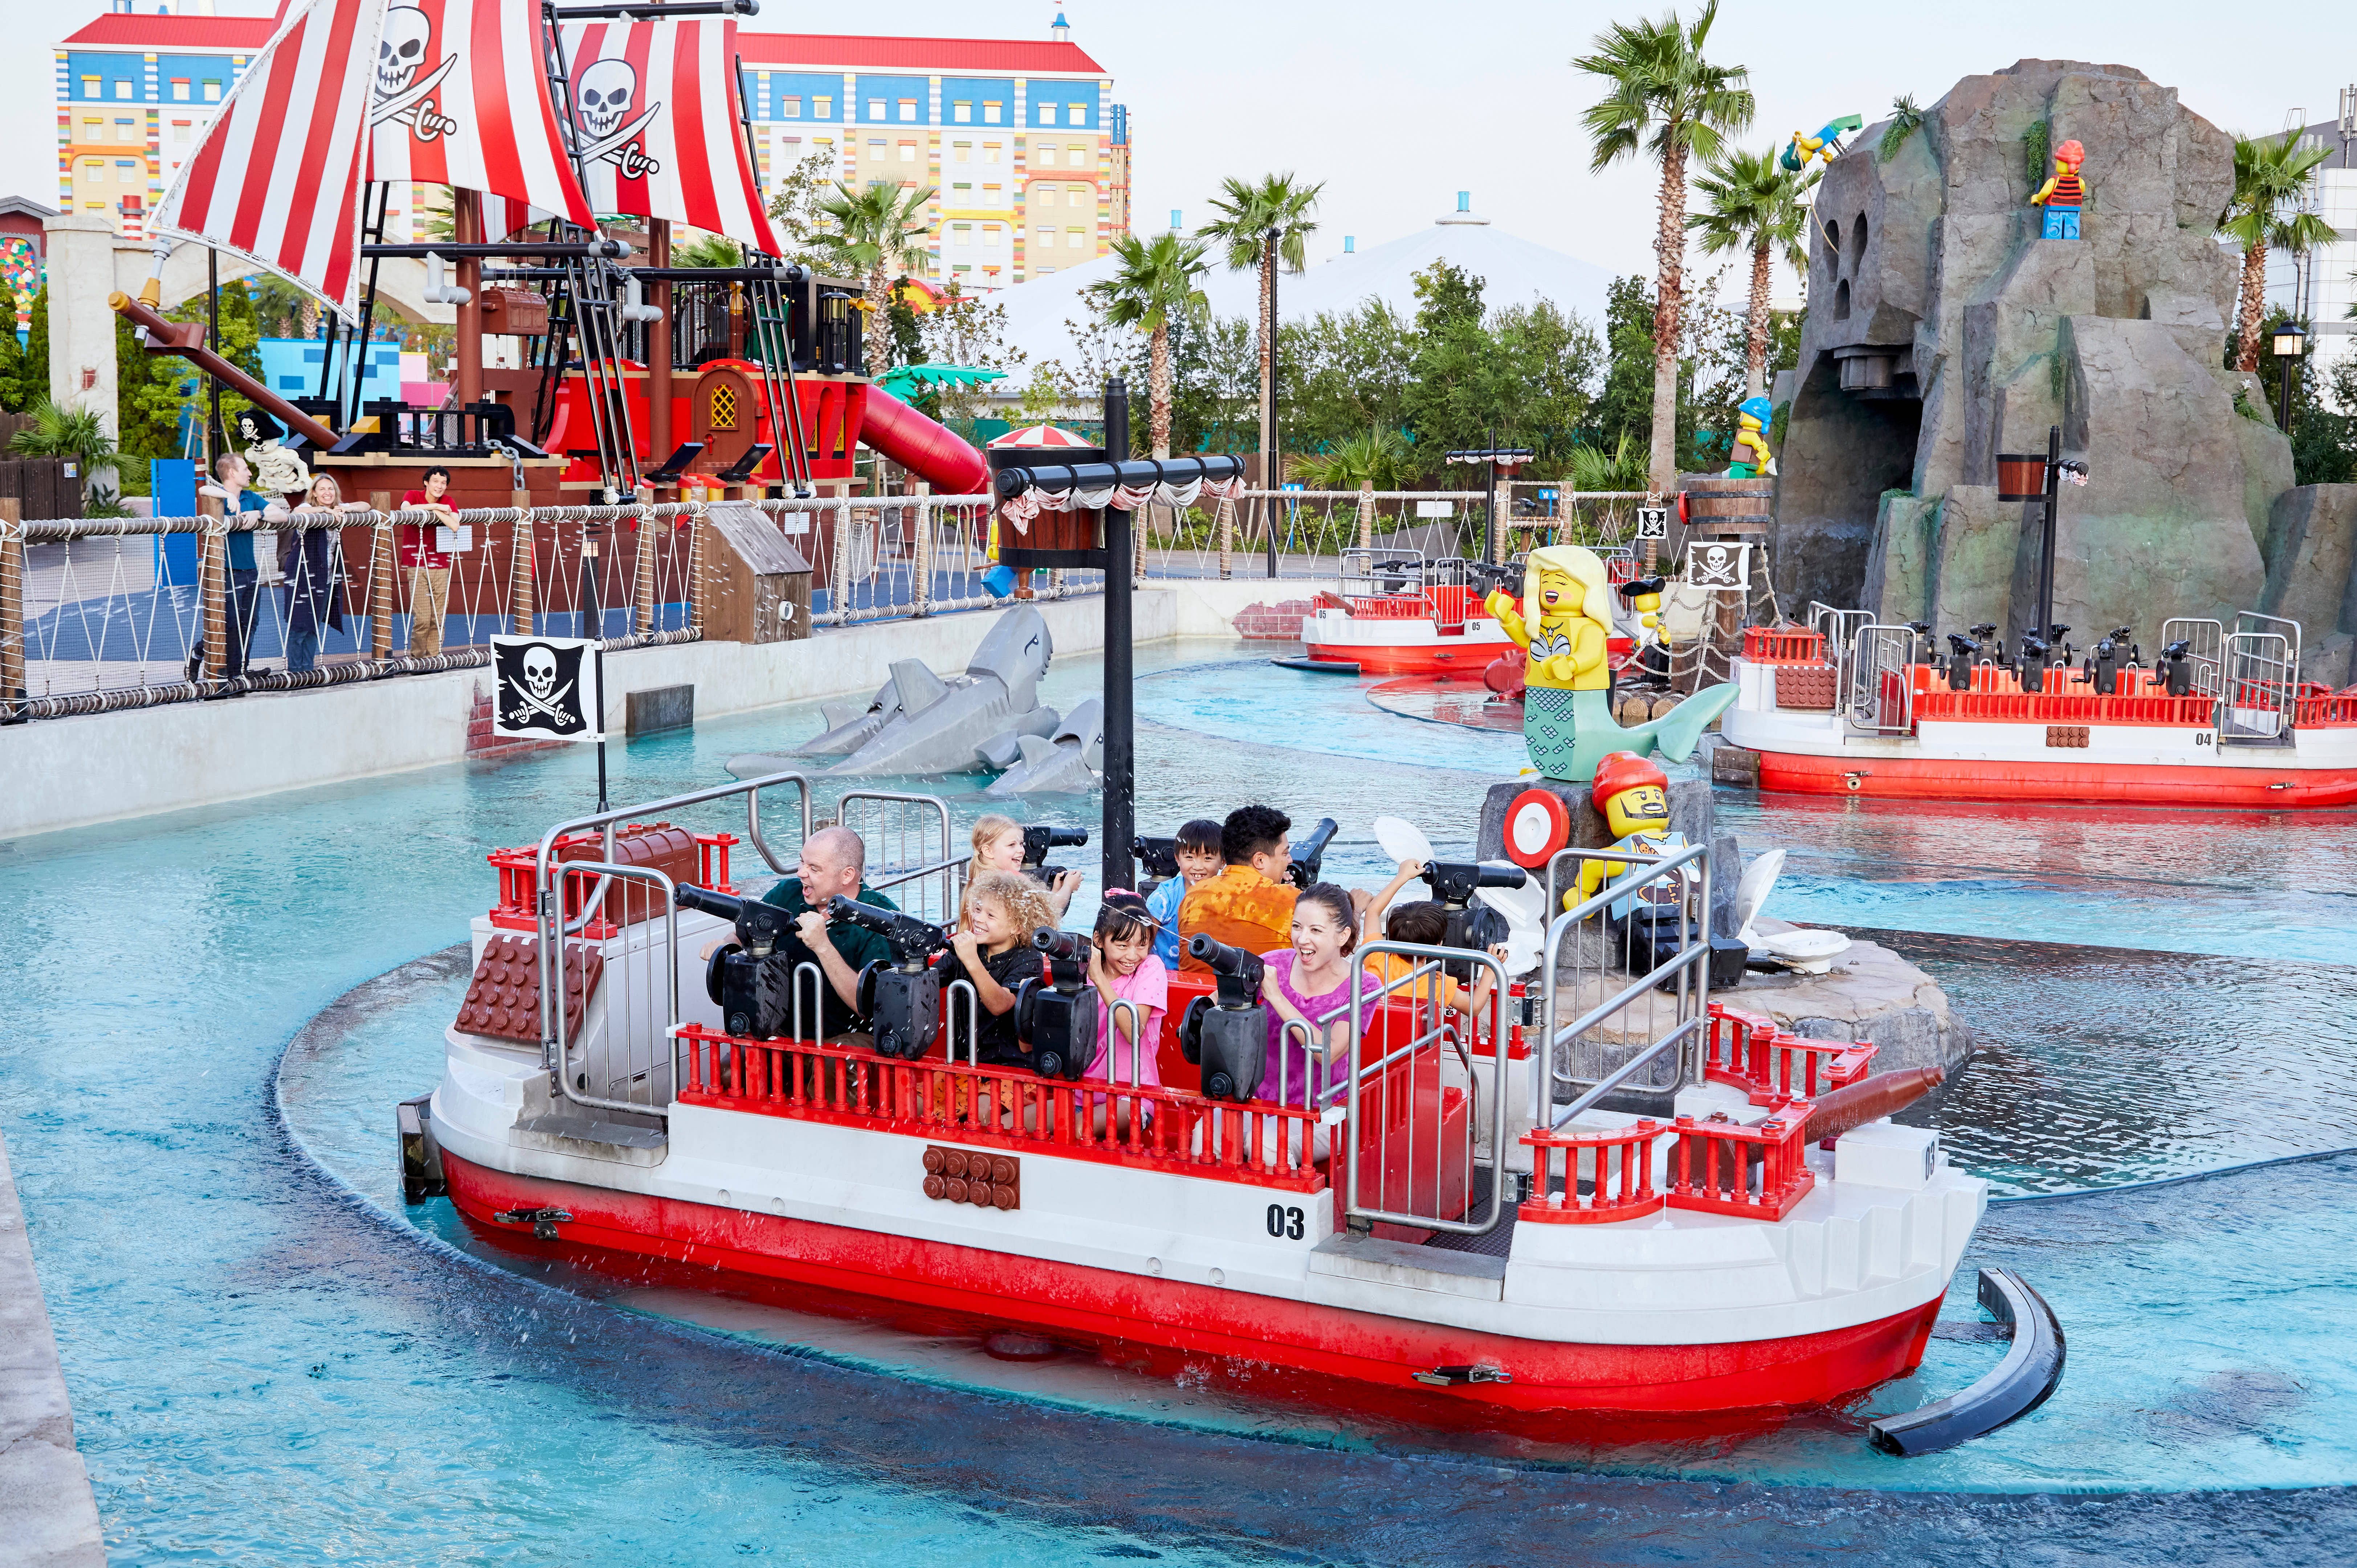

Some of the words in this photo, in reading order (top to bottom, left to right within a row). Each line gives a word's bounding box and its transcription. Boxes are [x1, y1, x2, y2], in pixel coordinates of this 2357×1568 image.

[1319, 610, 1326, 619] 05
[1472, 622, 1480, 630] 05
[2196, 733, 2211, 746] 04
[1925, 1141, 1935, 1181] 03
[1267, 1204, 1304, 1240] 03
